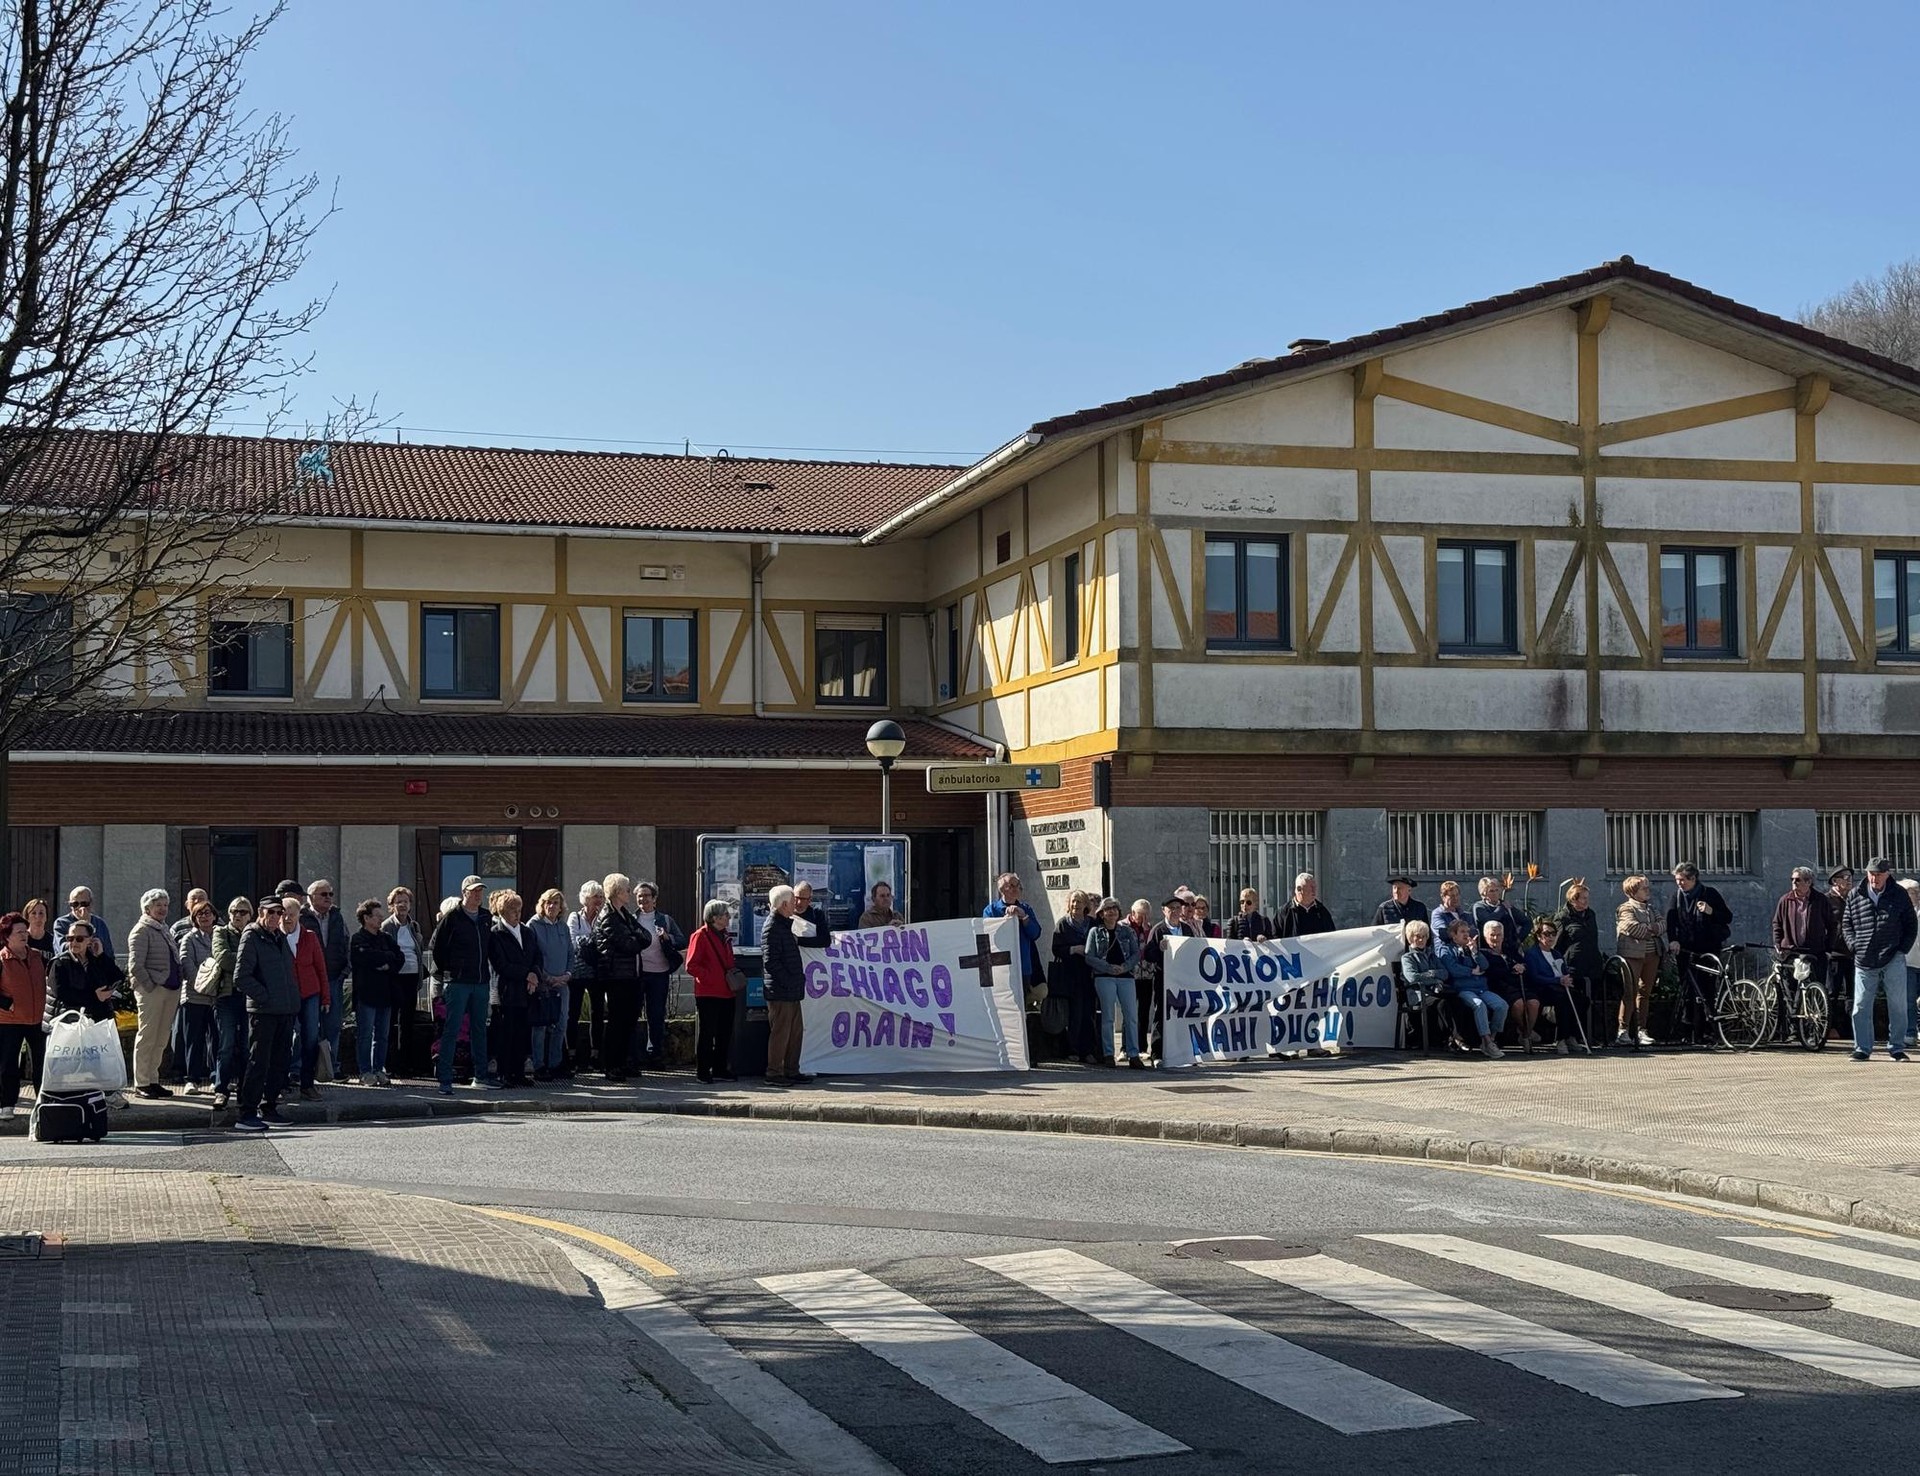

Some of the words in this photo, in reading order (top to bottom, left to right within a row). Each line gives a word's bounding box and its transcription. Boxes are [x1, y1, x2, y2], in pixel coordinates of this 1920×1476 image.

[938, 773, 1001, 785] anbulatorioa
[1199, 946, 1303, 984] ORION
[804, 961, 953, 1008] GEHIAGO
[1189, 1017, 1257, 1056] NAHI
